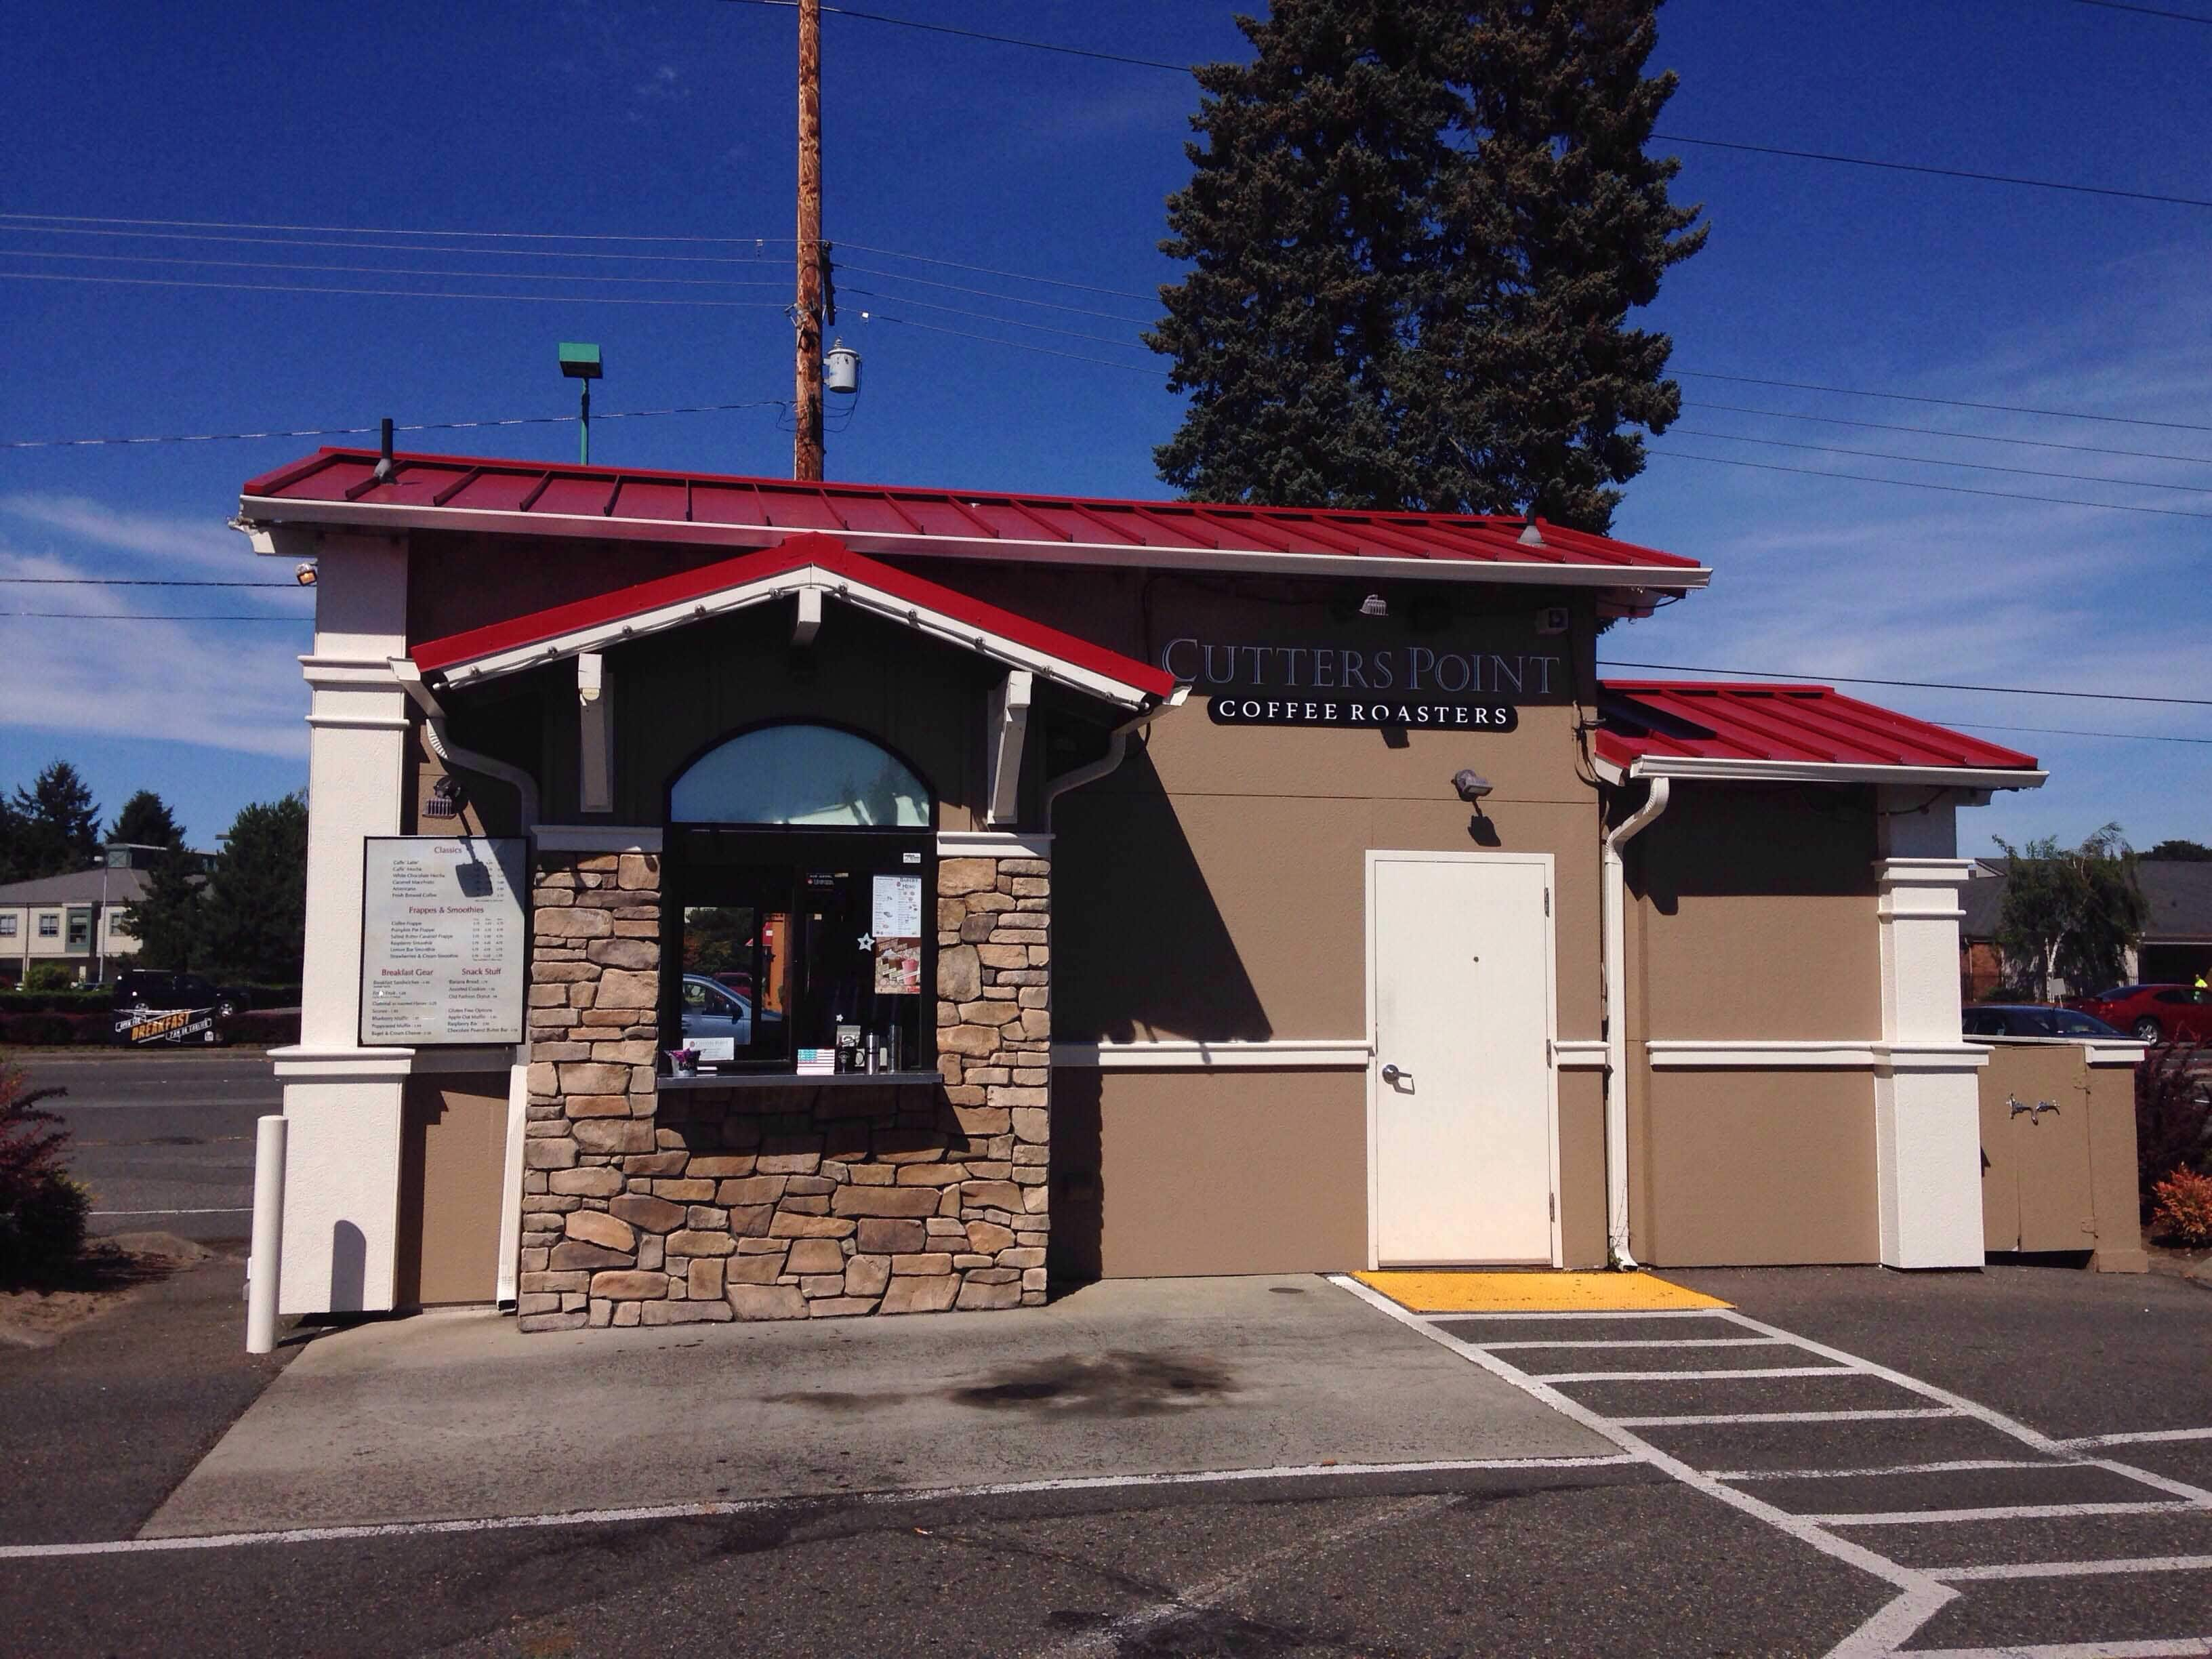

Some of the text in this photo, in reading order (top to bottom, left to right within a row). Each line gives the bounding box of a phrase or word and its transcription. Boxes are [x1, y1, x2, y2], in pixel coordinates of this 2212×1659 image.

[1162, 638, 1559, 694] CUTTERS POINT
[1219, 699, 1507, 725] COFFEE ROASTERS
[409, 906, 437, 915] Frappes
[447, 905, 485, 914] Smoothies
[485, 967, 501, 975] Stuff
[131, 1012, 190, 1042] BREAKFAST
